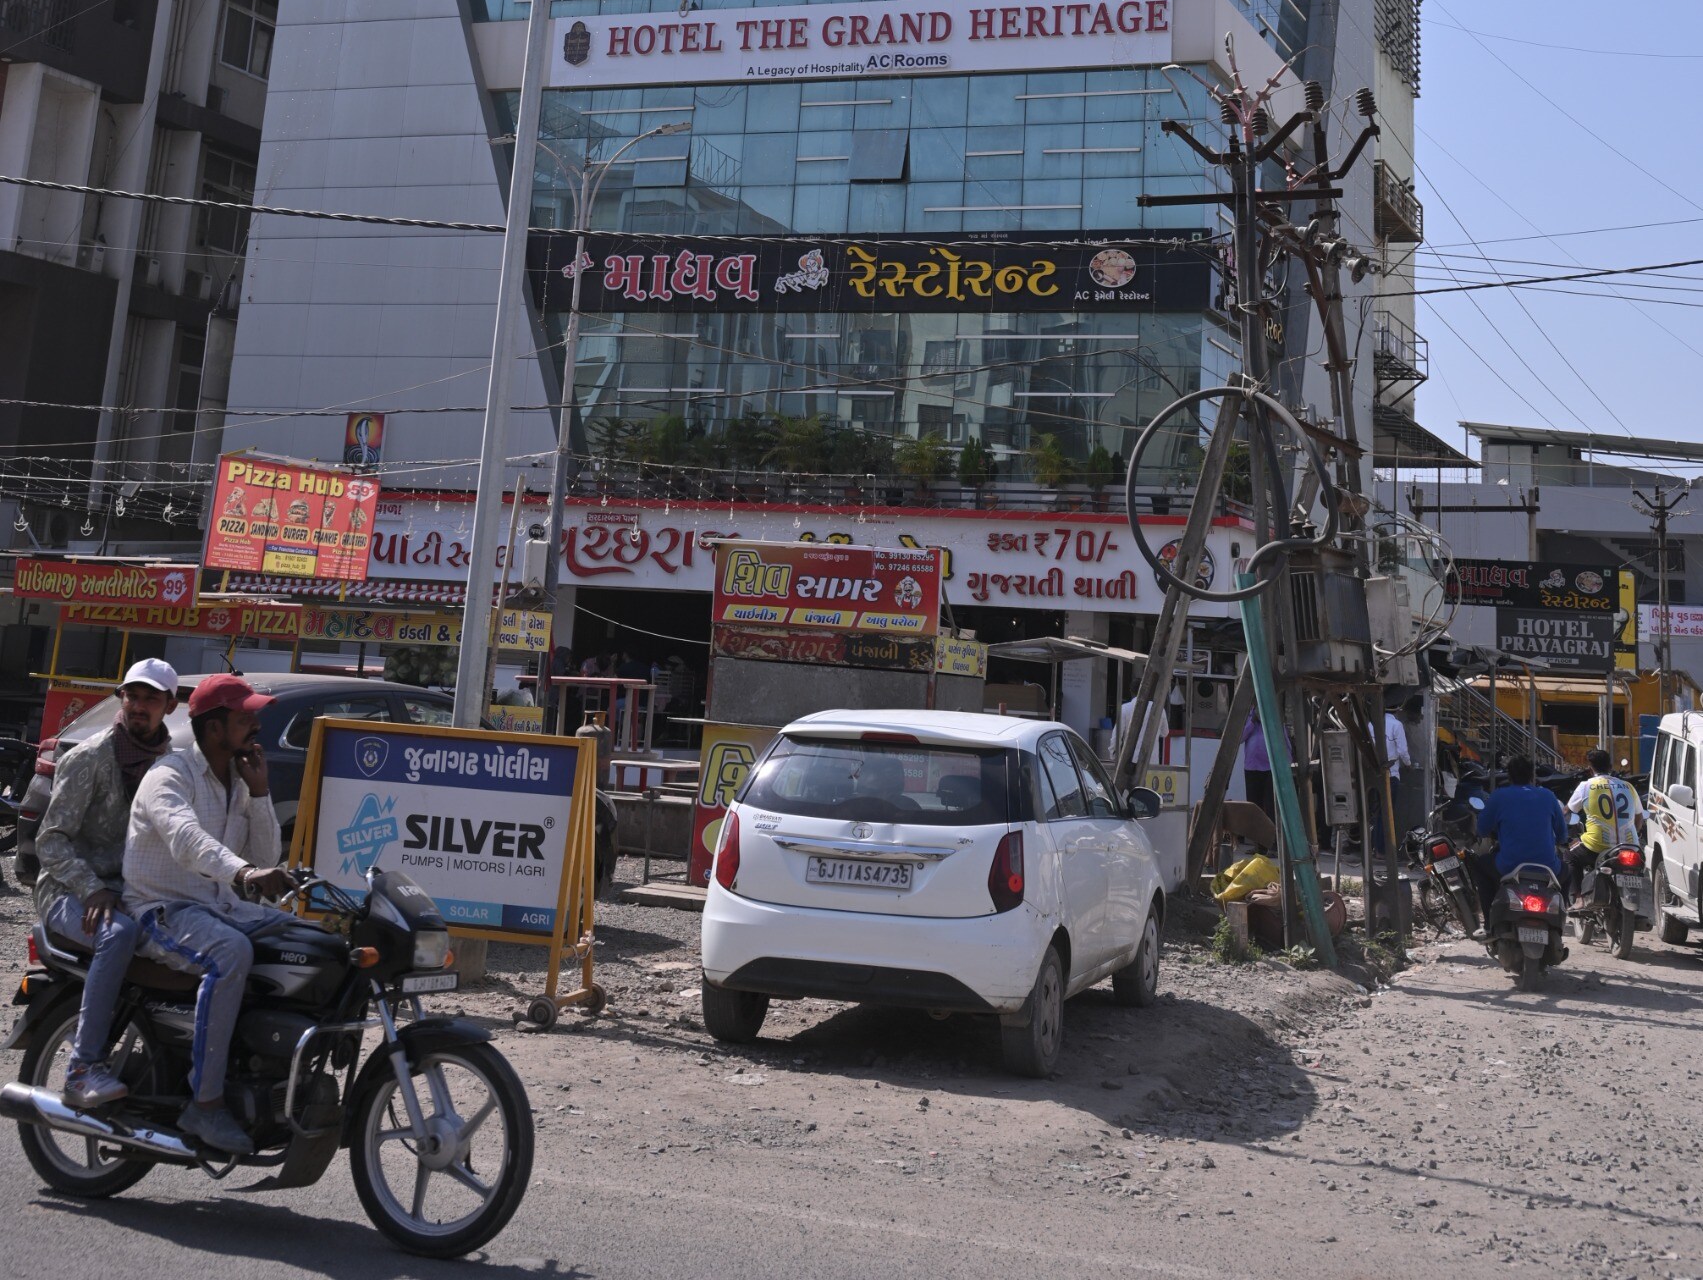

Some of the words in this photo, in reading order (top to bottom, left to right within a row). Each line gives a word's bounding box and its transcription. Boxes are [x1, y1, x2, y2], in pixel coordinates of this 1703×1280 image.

[606, 22, 722, 56] HOTEL
[736, 18, 808, 50] THE
[822, 11, 952, 47] GRAND
[969, 0, 1168, 40] HERITAGE
[747, 65, 755, 76] A
[757, 64, 797, 77] Legacy
[798, 63, 808, 74] of
[811, 61, 865, 74] Hospitality
[867, 54, 890, 68] AC
[895, 53, 947, 68] Rooms
[604, 249, 759, 302] માધવ
[847, 246, 1060, 302] રેસ્ટોરન્ટ
[1075, 291, 1089, 300] AC
[227, 461, 292, 491] Pizza
[298, 473, 344, 498] Hub
[350, 484, 371, 497] 59
[220, 519, 246, 534] PIZZA
[283, 528, 308, 542] BURGER
[987, 530, 1028, 553] ફક્ત
[166, 579, 183, 595] 99
[724, 550, 792, 598] શિવ
[796, 576, 883, 602] સાગર
[967, 567, 1065, 601] ગુજરાતી
[1074, 569, 1137, 600] થાળી
[1459, 565, 1529, 589] માધવ
[1540, 589, 1611, 610] રેસ્ટોરન્ટ
[68, 604, 138, 622] PIZZA
[146, 606, 200, 626] HUB
[240, 610, 298, 635] PIZZA
[804, 612, 842, 625] પંજાબી
[866, 616, 886, 628] આલુ
[1517, 618, 1594, 638] HOTEL
[437, 624, 450, 641] &
[1501, 635, 1610, 659] PRAYAGRAJ
[484, 745, 550, 782] પોલીસ
[1598, 793, 1629, 820] 02
[341, 822, 394, 848] SILVER
[403, 814, 547, 860] SILVER
[402, 854, 443, 869] PUMPS
[453, 859, 506, 874] MOTORS
[515, 864, 545, 877] AGRI
[818, 863, 909, 885] GJ11AS4735
[449, 905, 489, 919] SOLAR
[520, 912, 550, 925] AGRI
[280, 952, 307, 964] Hero
